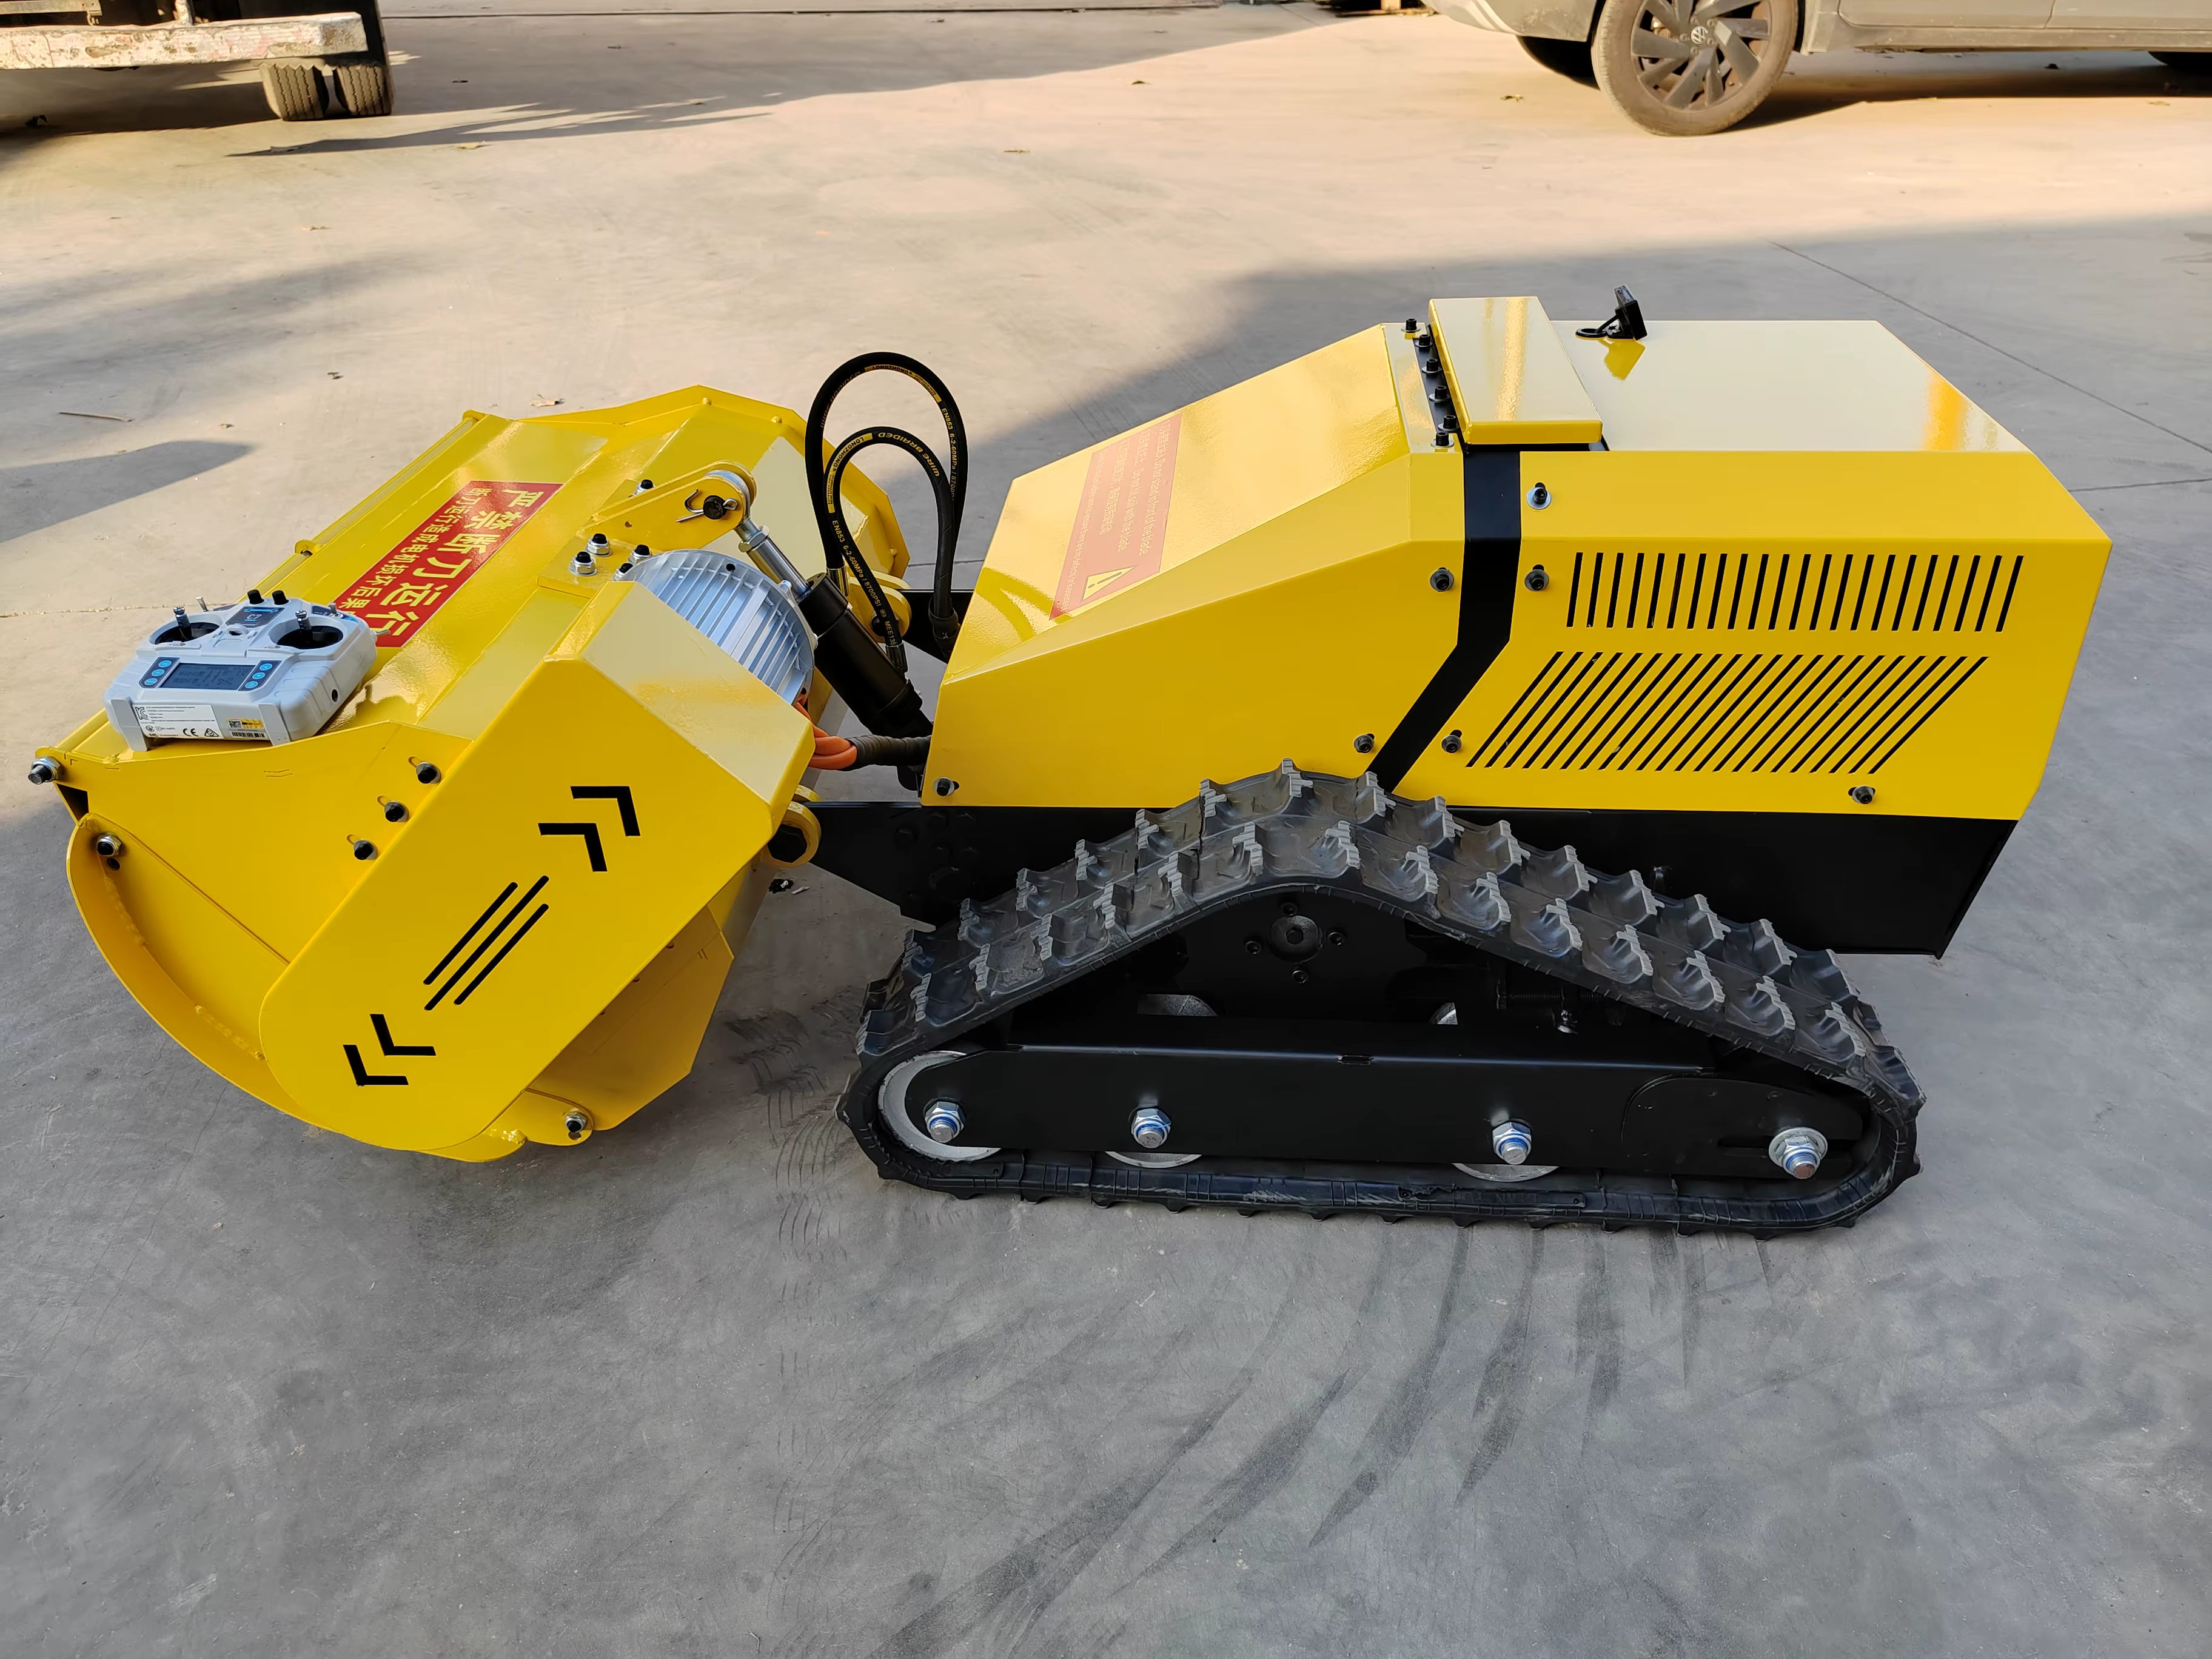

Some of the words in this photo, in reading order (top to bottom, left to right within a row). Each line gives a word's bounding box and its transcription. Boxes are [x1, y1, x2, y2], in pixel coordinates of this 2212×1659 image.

[878, 432, 923, 453] BRAIDED
[922, 453, 940, 477] WIRE
[1154, 458, 1165, 469] Do
[1132, 468, 1144, 479] Do
[1152, 469, 1163, 480] not
[1130, 478, 1140, 489] not
[1150, 478, 1161, 496] stand
[1127, 497, 1138, 509] soil
[1148, 494, 1160, 503] in
[1124, 508, 1136, 522] with
[1145, 501, 1159, 518] front
[1121, 520, 1134, 533] the
[1142, 523, 1155, 536] the
[1118, 531, 1131, 552] blade
[1139, 534, 1153, 555] blade
[338, 486, 493, 615] 断刀运行造成电机损坏后果
[365, 488, 545, 635] 严禁断刀运行
[832, 520, 845, 543] EN853
[864, 582, 882, 607] 8700PSI
